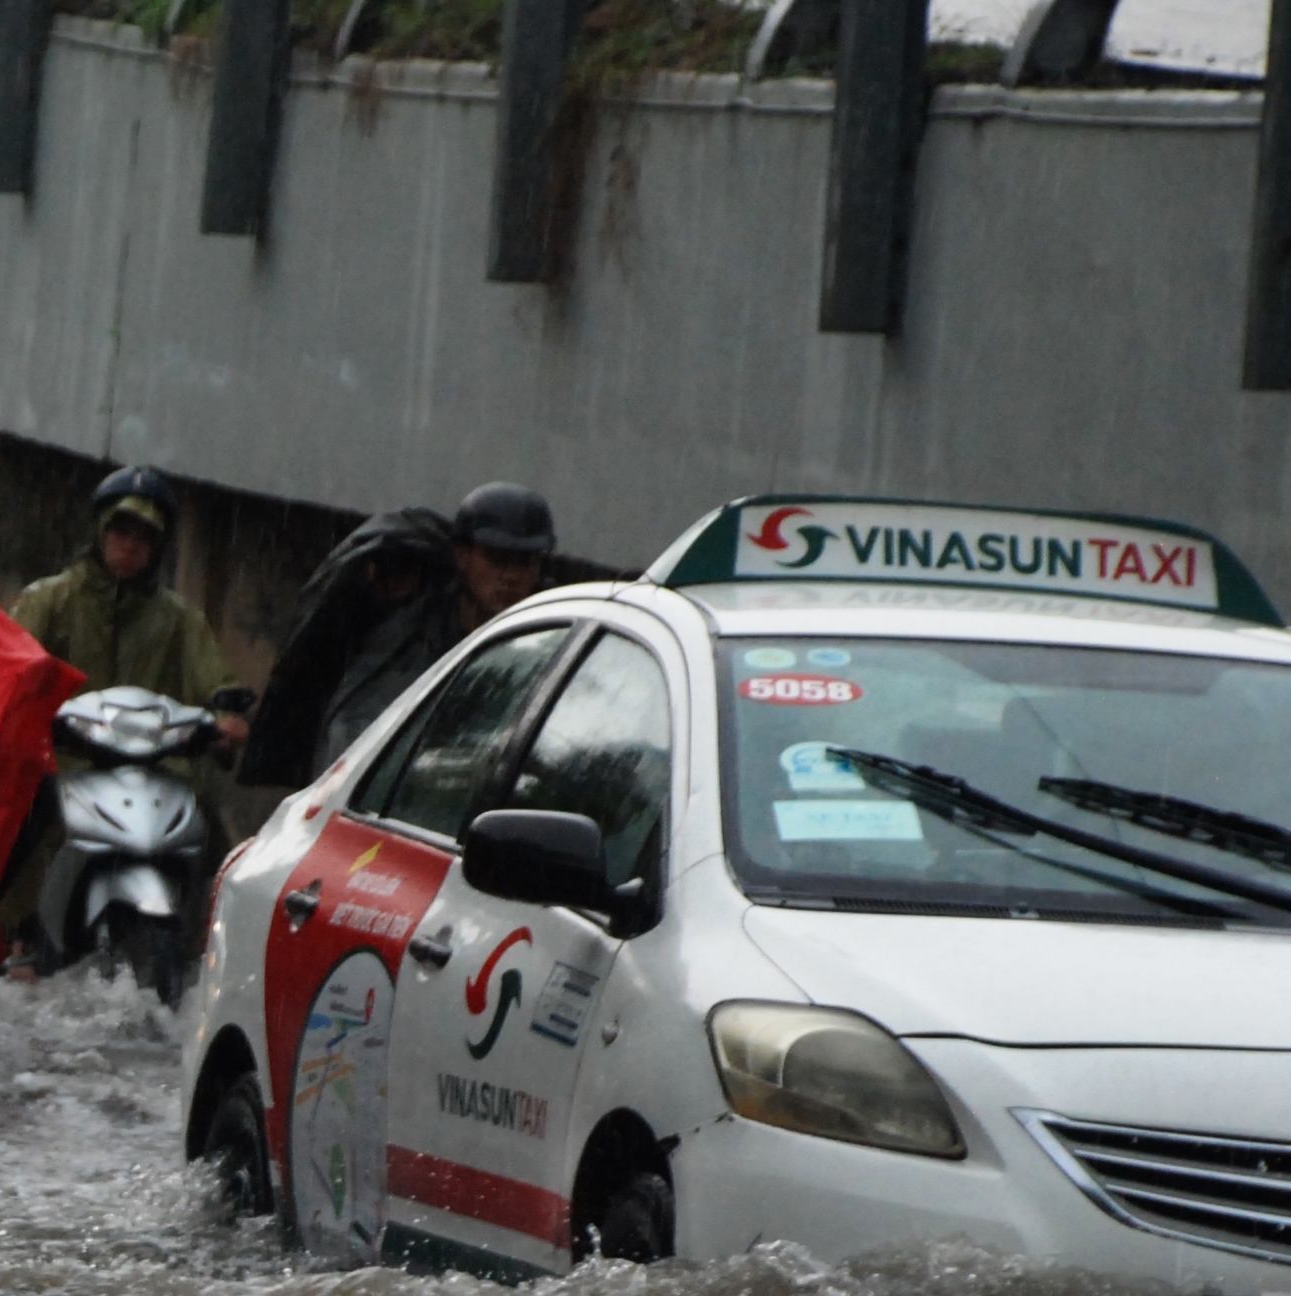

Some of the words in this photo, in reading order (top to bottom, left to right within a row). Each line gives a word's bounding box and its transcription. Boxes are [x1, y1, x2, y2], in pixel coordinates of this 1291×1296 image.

[844, 524, 1082, 579] VINASUN
[1088, 537, 1197, 588] TAXI
[748, 677, 853, 702] 5058
